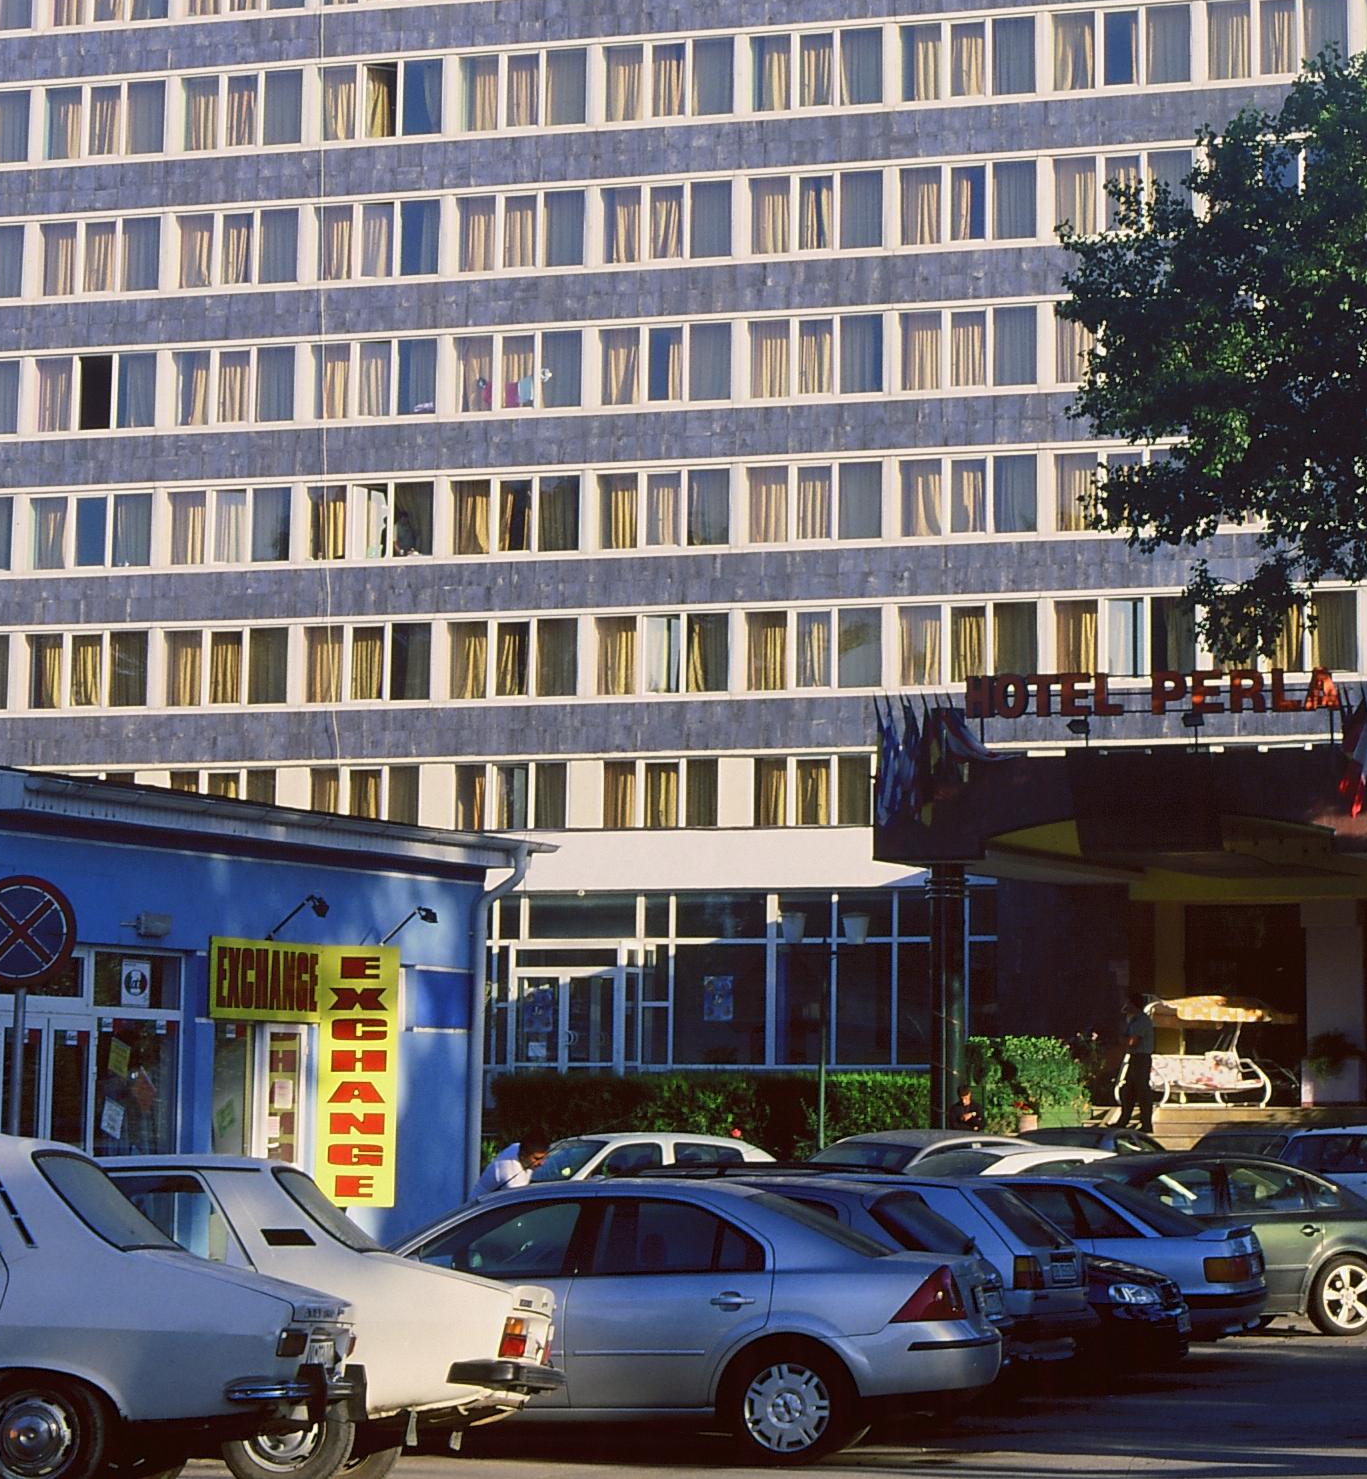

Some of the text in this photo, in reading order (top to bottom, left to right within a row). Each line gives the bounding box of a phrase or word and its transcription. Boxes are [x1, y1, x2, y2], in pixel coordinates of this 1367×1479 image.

[966, 667, 1341, 718] HOTEL PERLA
[215, 946, 319, 1012] EXCHANGE
[327, 956, 388, 1197] EXCHANGE
